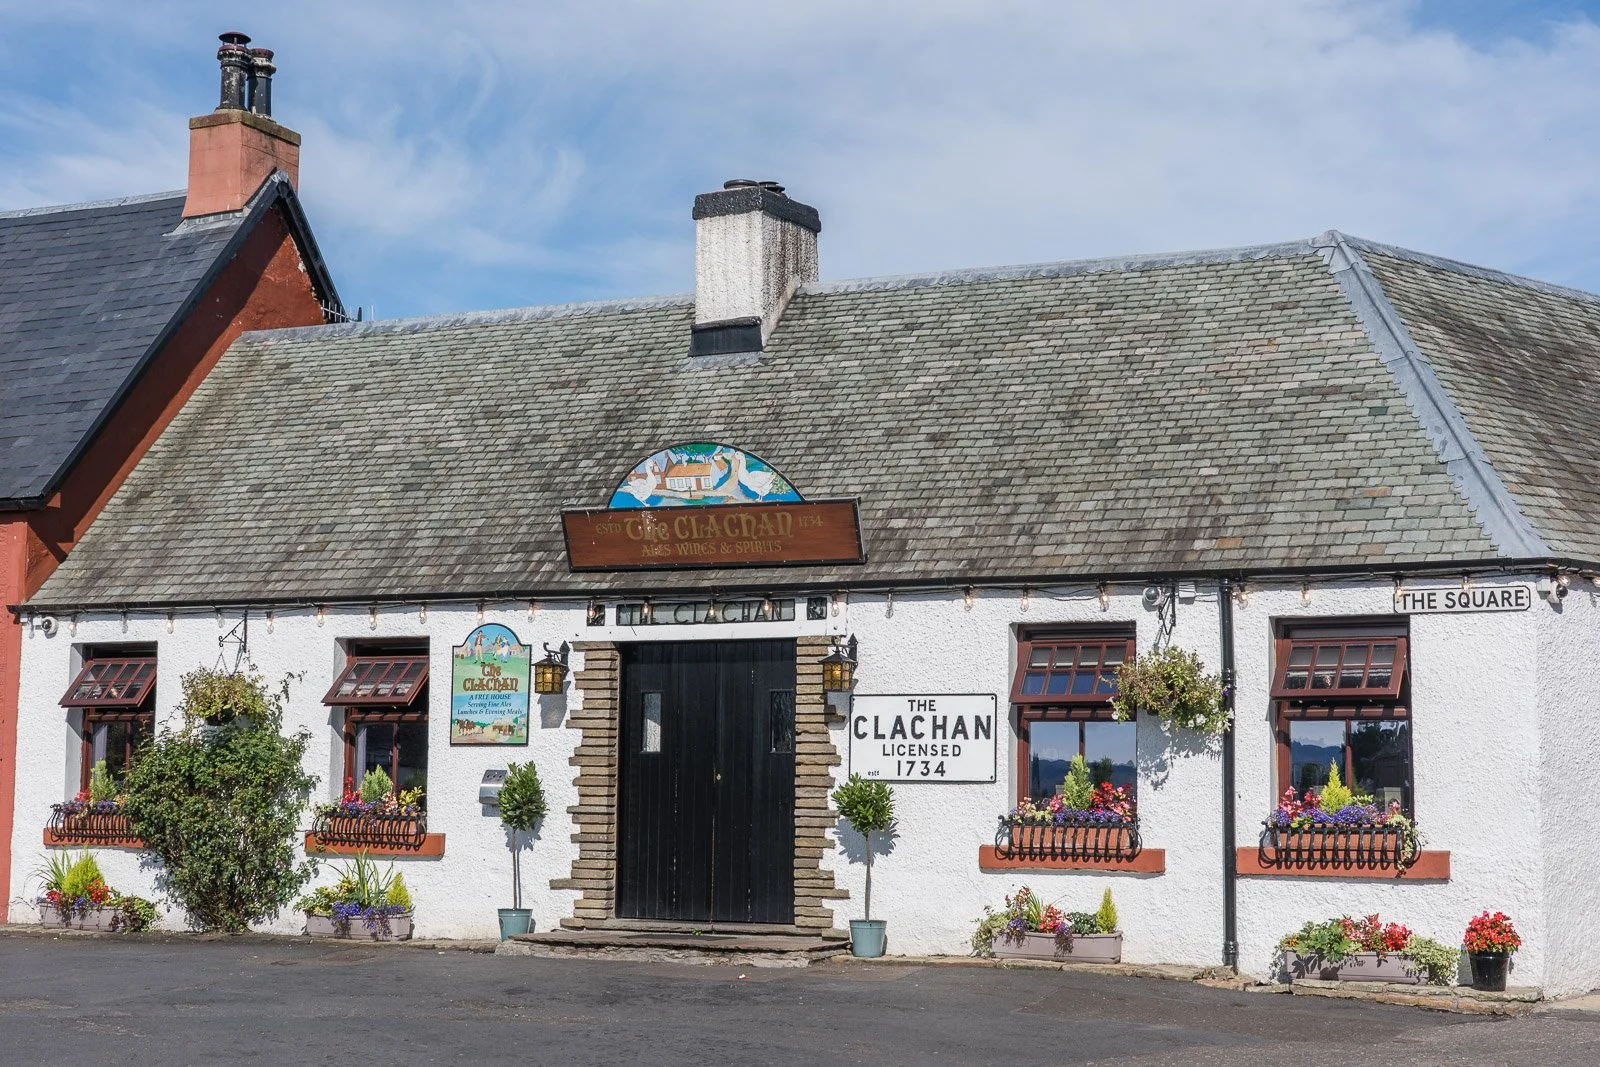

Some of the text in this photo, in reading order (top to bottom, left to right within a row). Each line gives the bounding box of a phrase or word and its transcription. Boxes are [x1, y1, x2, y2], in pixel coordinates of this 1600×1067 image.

[674, 511, 794, 540] CLACHAN
[798, 515, 824, 529] 1734
[675, 541, 717, 556] WINES
[720, 541, 732, 555] &
[735, 540, 782, 555] SPIRITS
[1401, 589, 1525, 610] THE SQUARE
[674, 600, 782, 624] CLACHAN
[481, 663, 501, 677] The
[463, 678, 518, 692] CLACHAN
[468, 701, 487, 709] Serving
[485, 708, 506, 716] Evening
[908, 699, 936, 712] THE
[853, 715, 992, 740] CLACHAN
[882, 743, 962, 757] LICENSED
[897, 760, 946, 777] 1734
